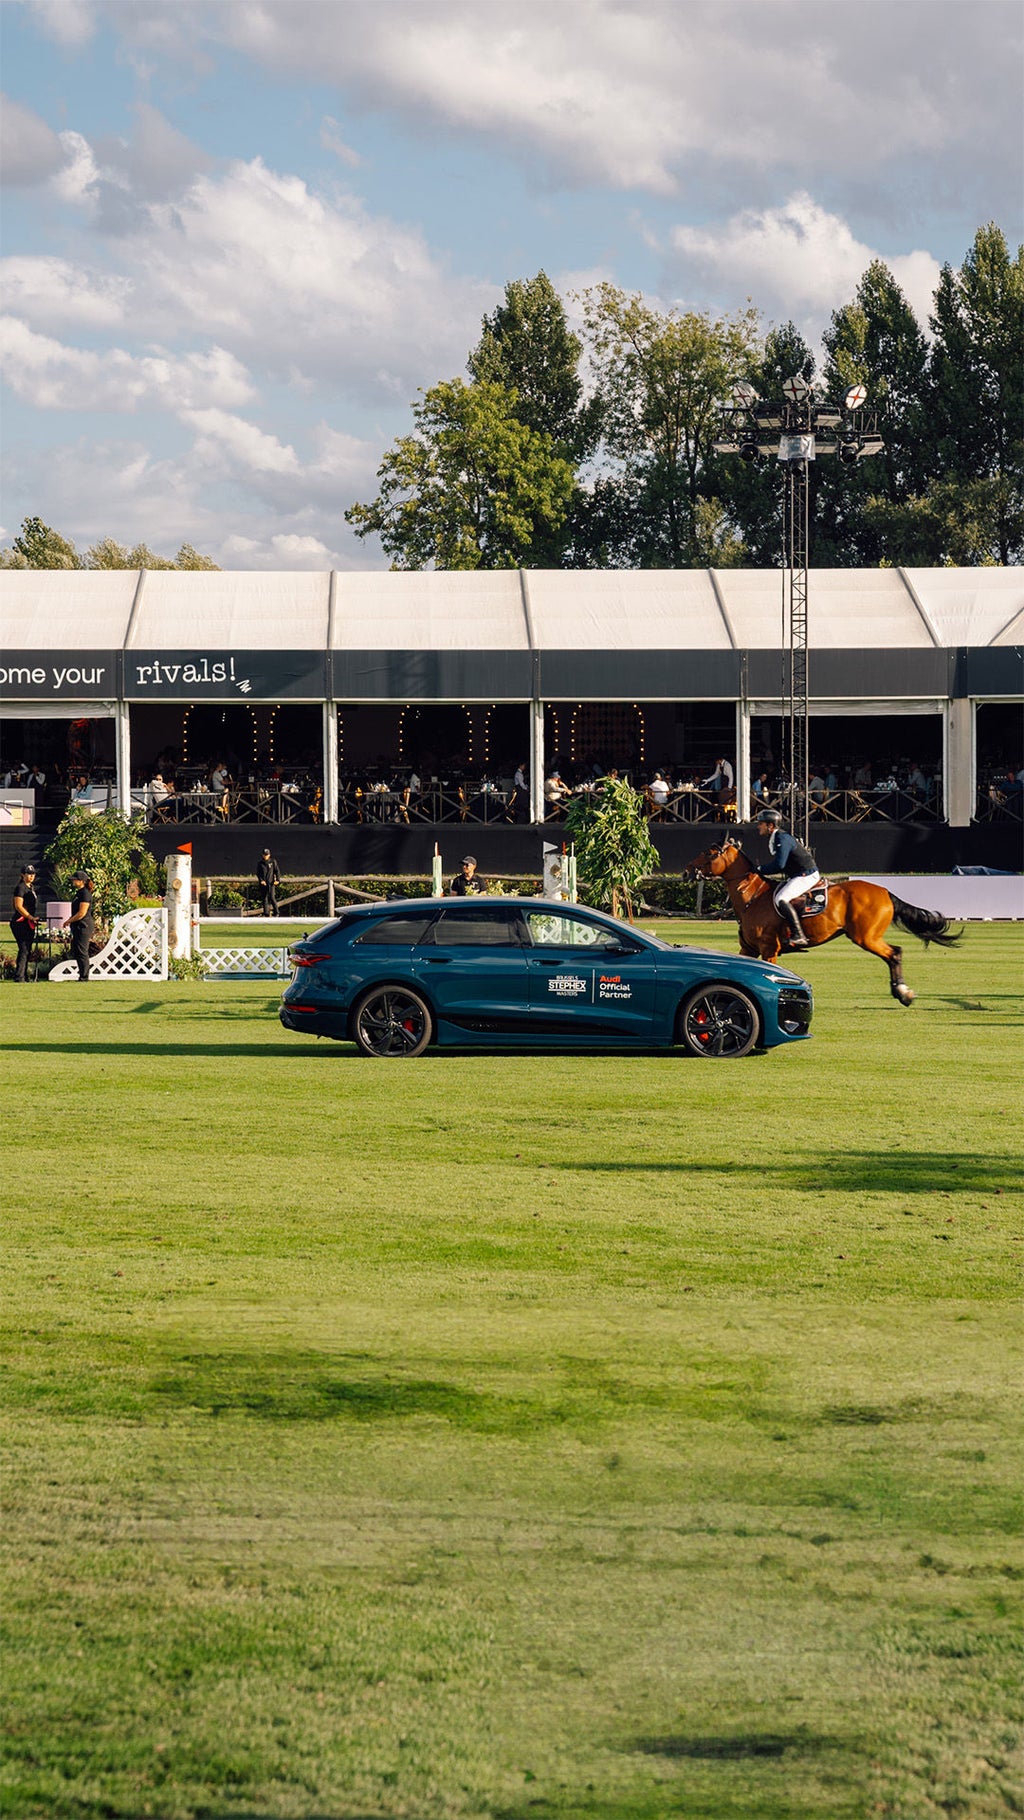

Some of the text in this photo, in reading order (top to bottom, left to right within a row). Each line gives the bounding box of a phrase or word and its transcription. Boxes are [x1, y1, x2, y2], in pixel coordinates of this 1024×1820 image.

[53, 668, 105, 689] your
[136, 657, 236, 684] rivals!
[548, 981, 586, 990] STEPHEX
[599, 983, 630, 991] Official
[599, 991, 632, 999] Partner
